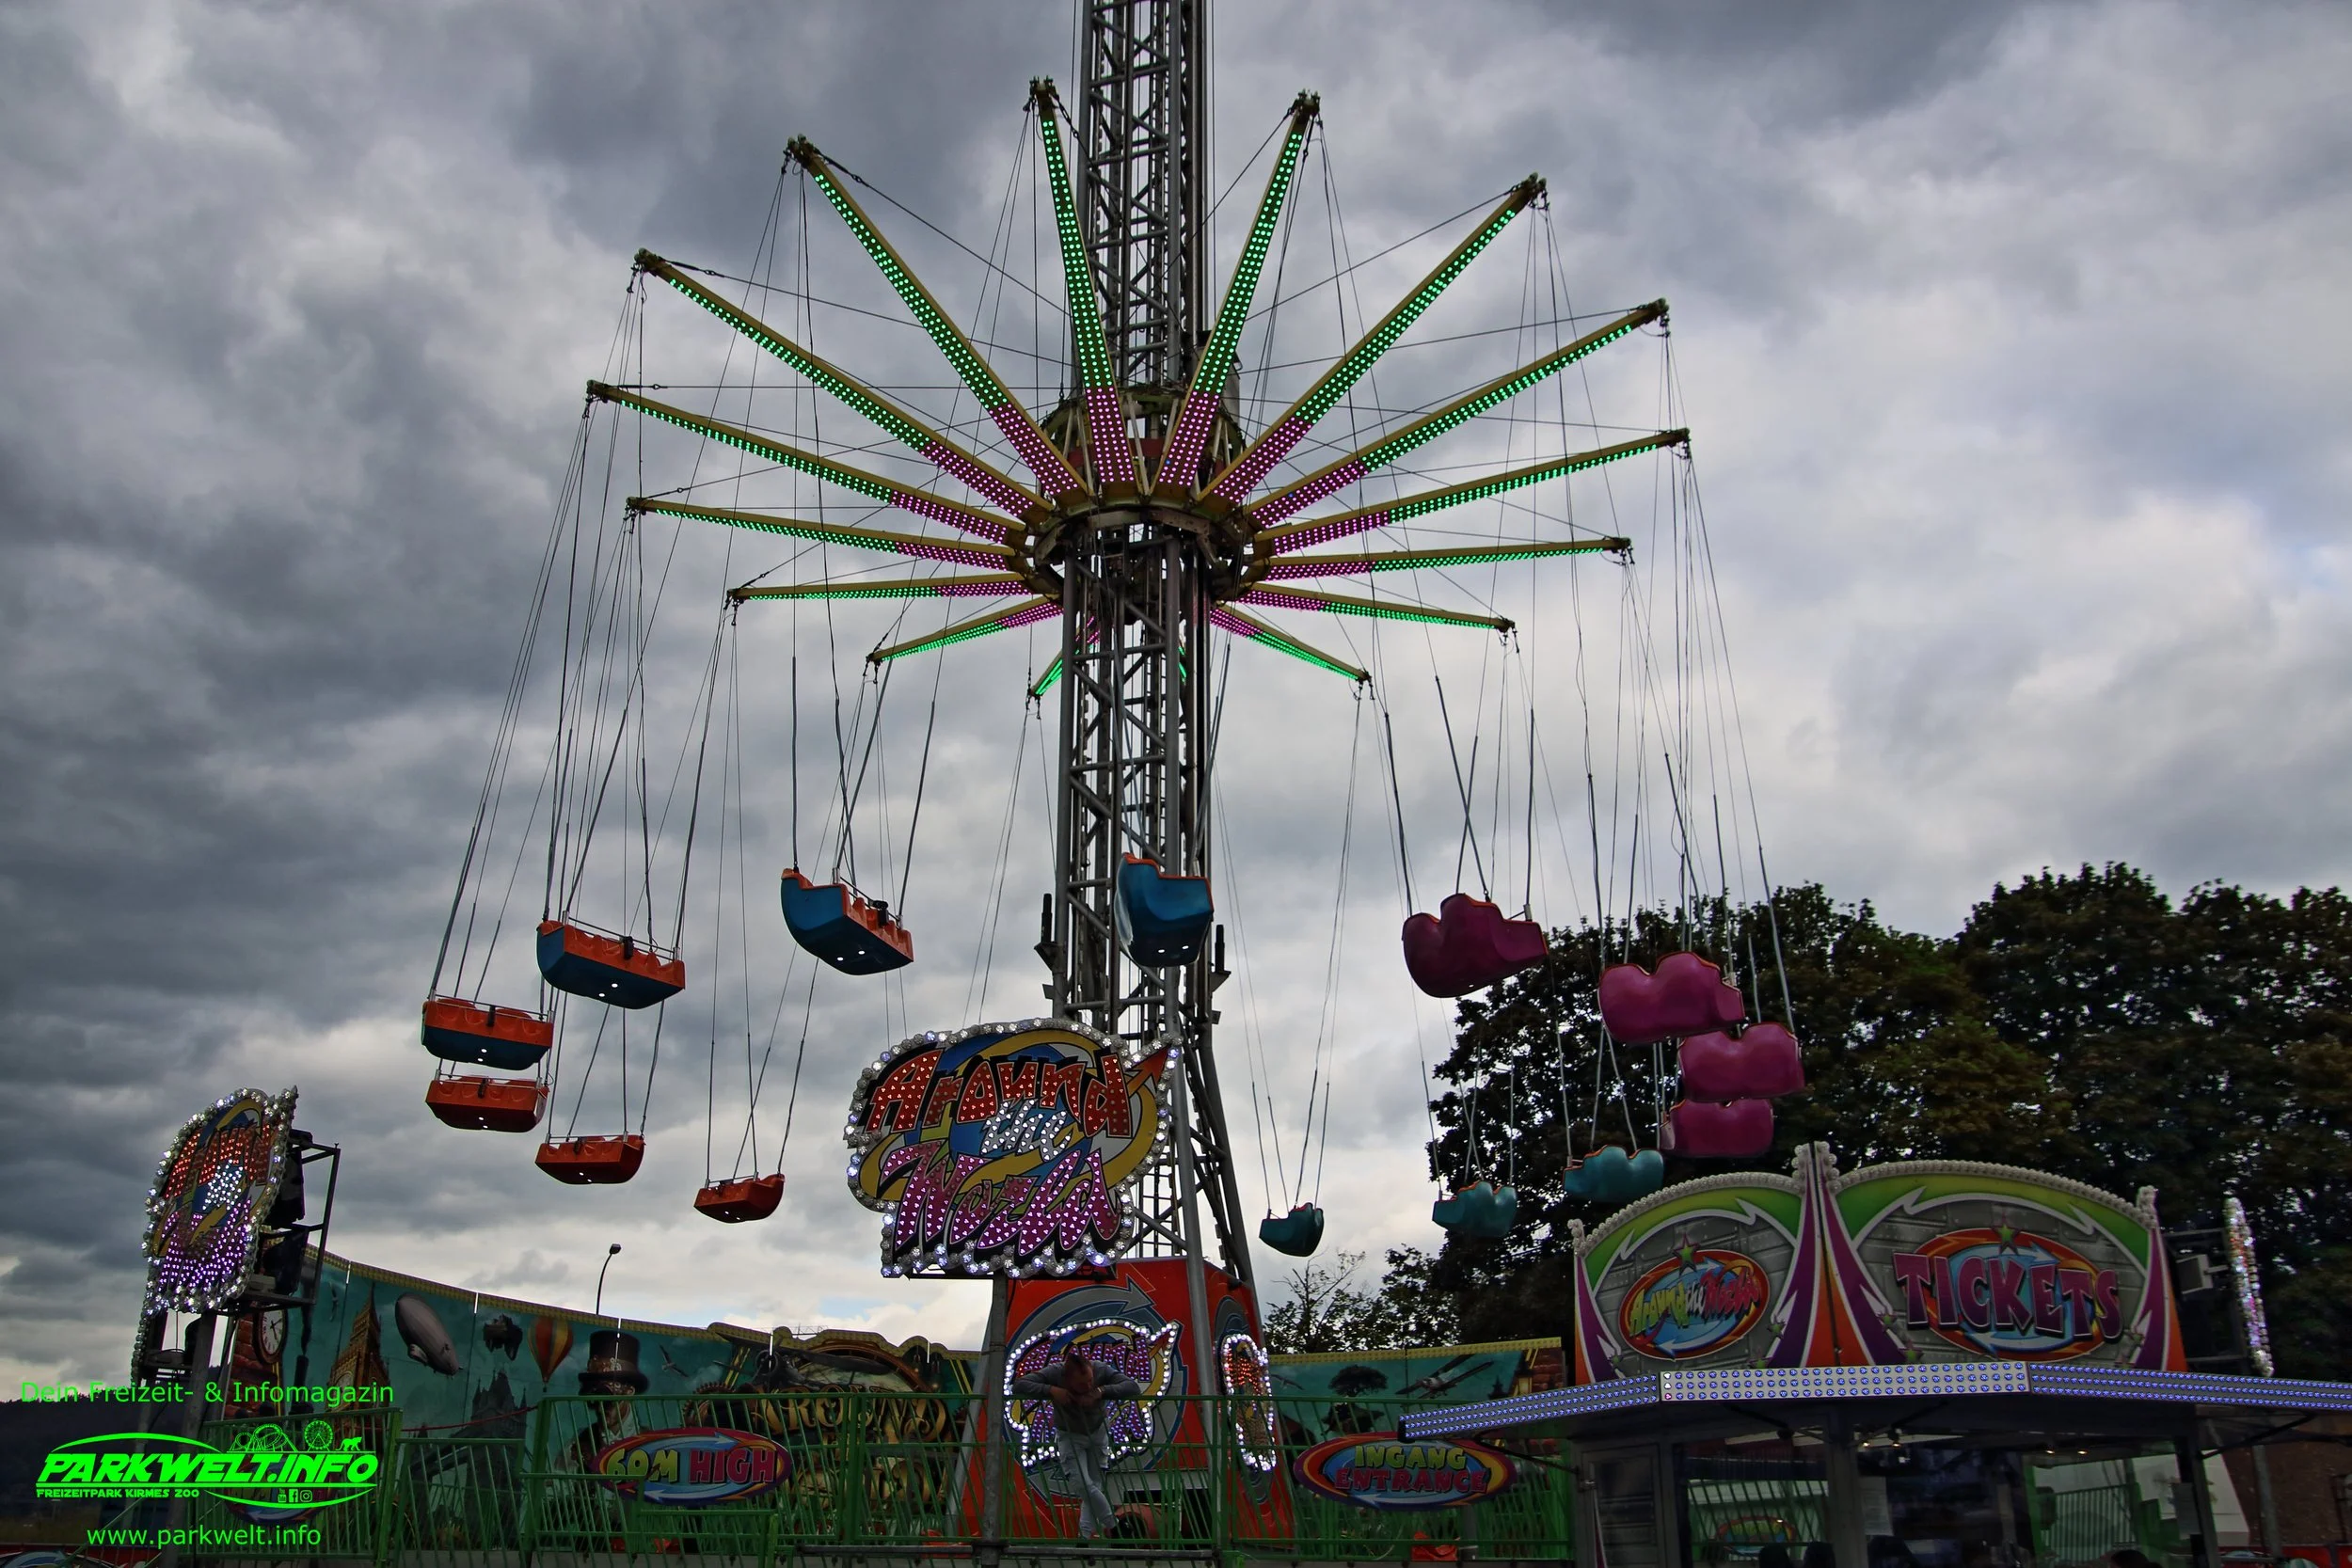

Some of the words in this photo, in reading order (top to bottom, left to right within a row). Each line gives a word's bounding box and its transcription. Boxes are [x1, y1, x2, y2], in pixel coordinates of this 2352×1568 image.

[866, 1048, 1131, 1137] Around
[980, 1099, 1072, 1161] the
[879, 1140, 1120, 1256] World
[1893, 1253, 2122, 1341] TICKETS
[689, 1449, 776, 1483] HIGH
[1334, 1468, 1487, 1494] ENTRANCE
[1355, 1445, 1467, 1470] INGANG
